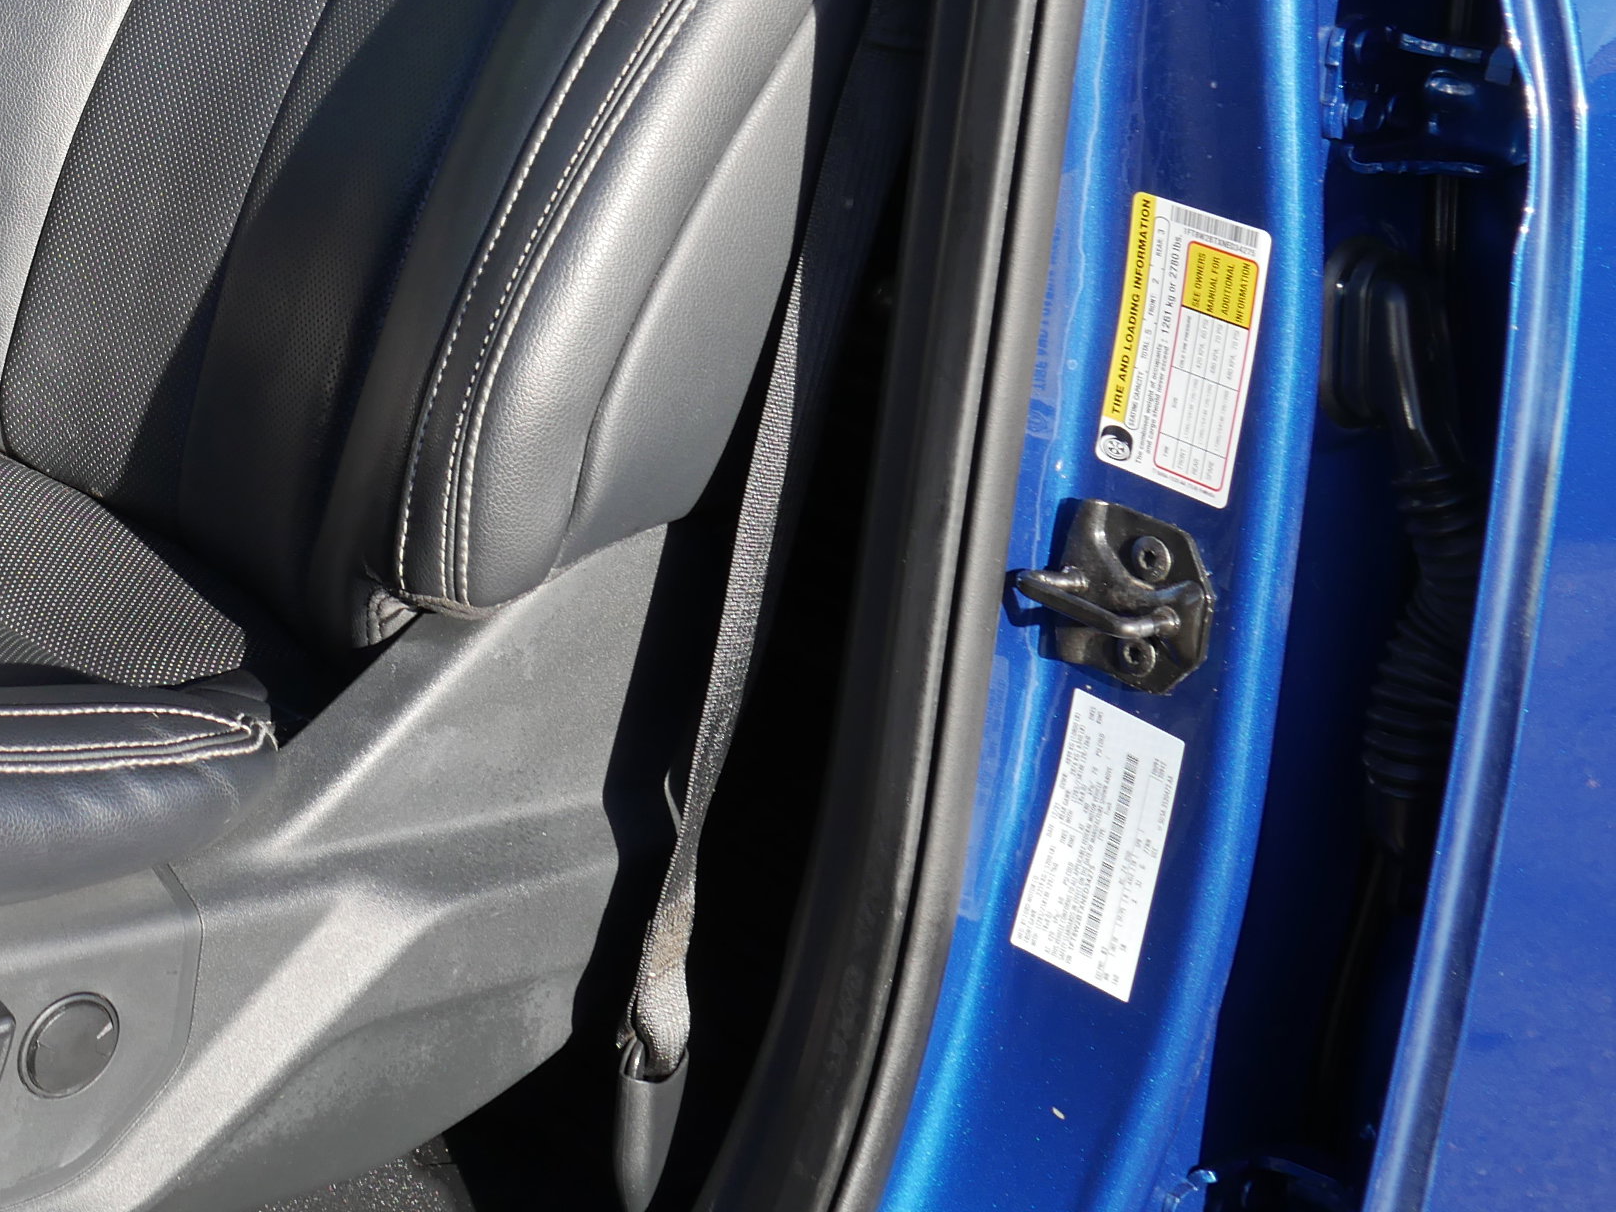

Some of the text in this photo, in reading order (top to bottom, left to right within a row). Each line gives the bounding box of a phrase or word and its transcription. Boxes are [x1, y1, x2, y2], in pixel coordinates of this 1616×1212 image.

[1168, 252, 1179, 279] 2780
[1168, 281, 1176, 292] or
[1191, 252, 1206, 307] SEE OWNERS
[1205, 256, 1220, 312] MANUAL FOR
[1220, 264, 1235, 315] ADDITIONAL
[1234, 262, 1251, 323] INFORMATION
[1111, 198, 1150, 413] TIRE AND LOADING INFORMATION
[1164, 294, 1176, 307] kg
[1160, 310, 1172, 333] 1261
[1160, 345, 1169, 371] exceed
[1156, 372, 1164, 393] never
[1128, 370, 1144, 426] SEATING CAPACITY
[1135, 343, 1163, 464] The combined weight of occupants
[1151, 393, 1161, 417] should
[1147, 418, 1157, 439] cargo
